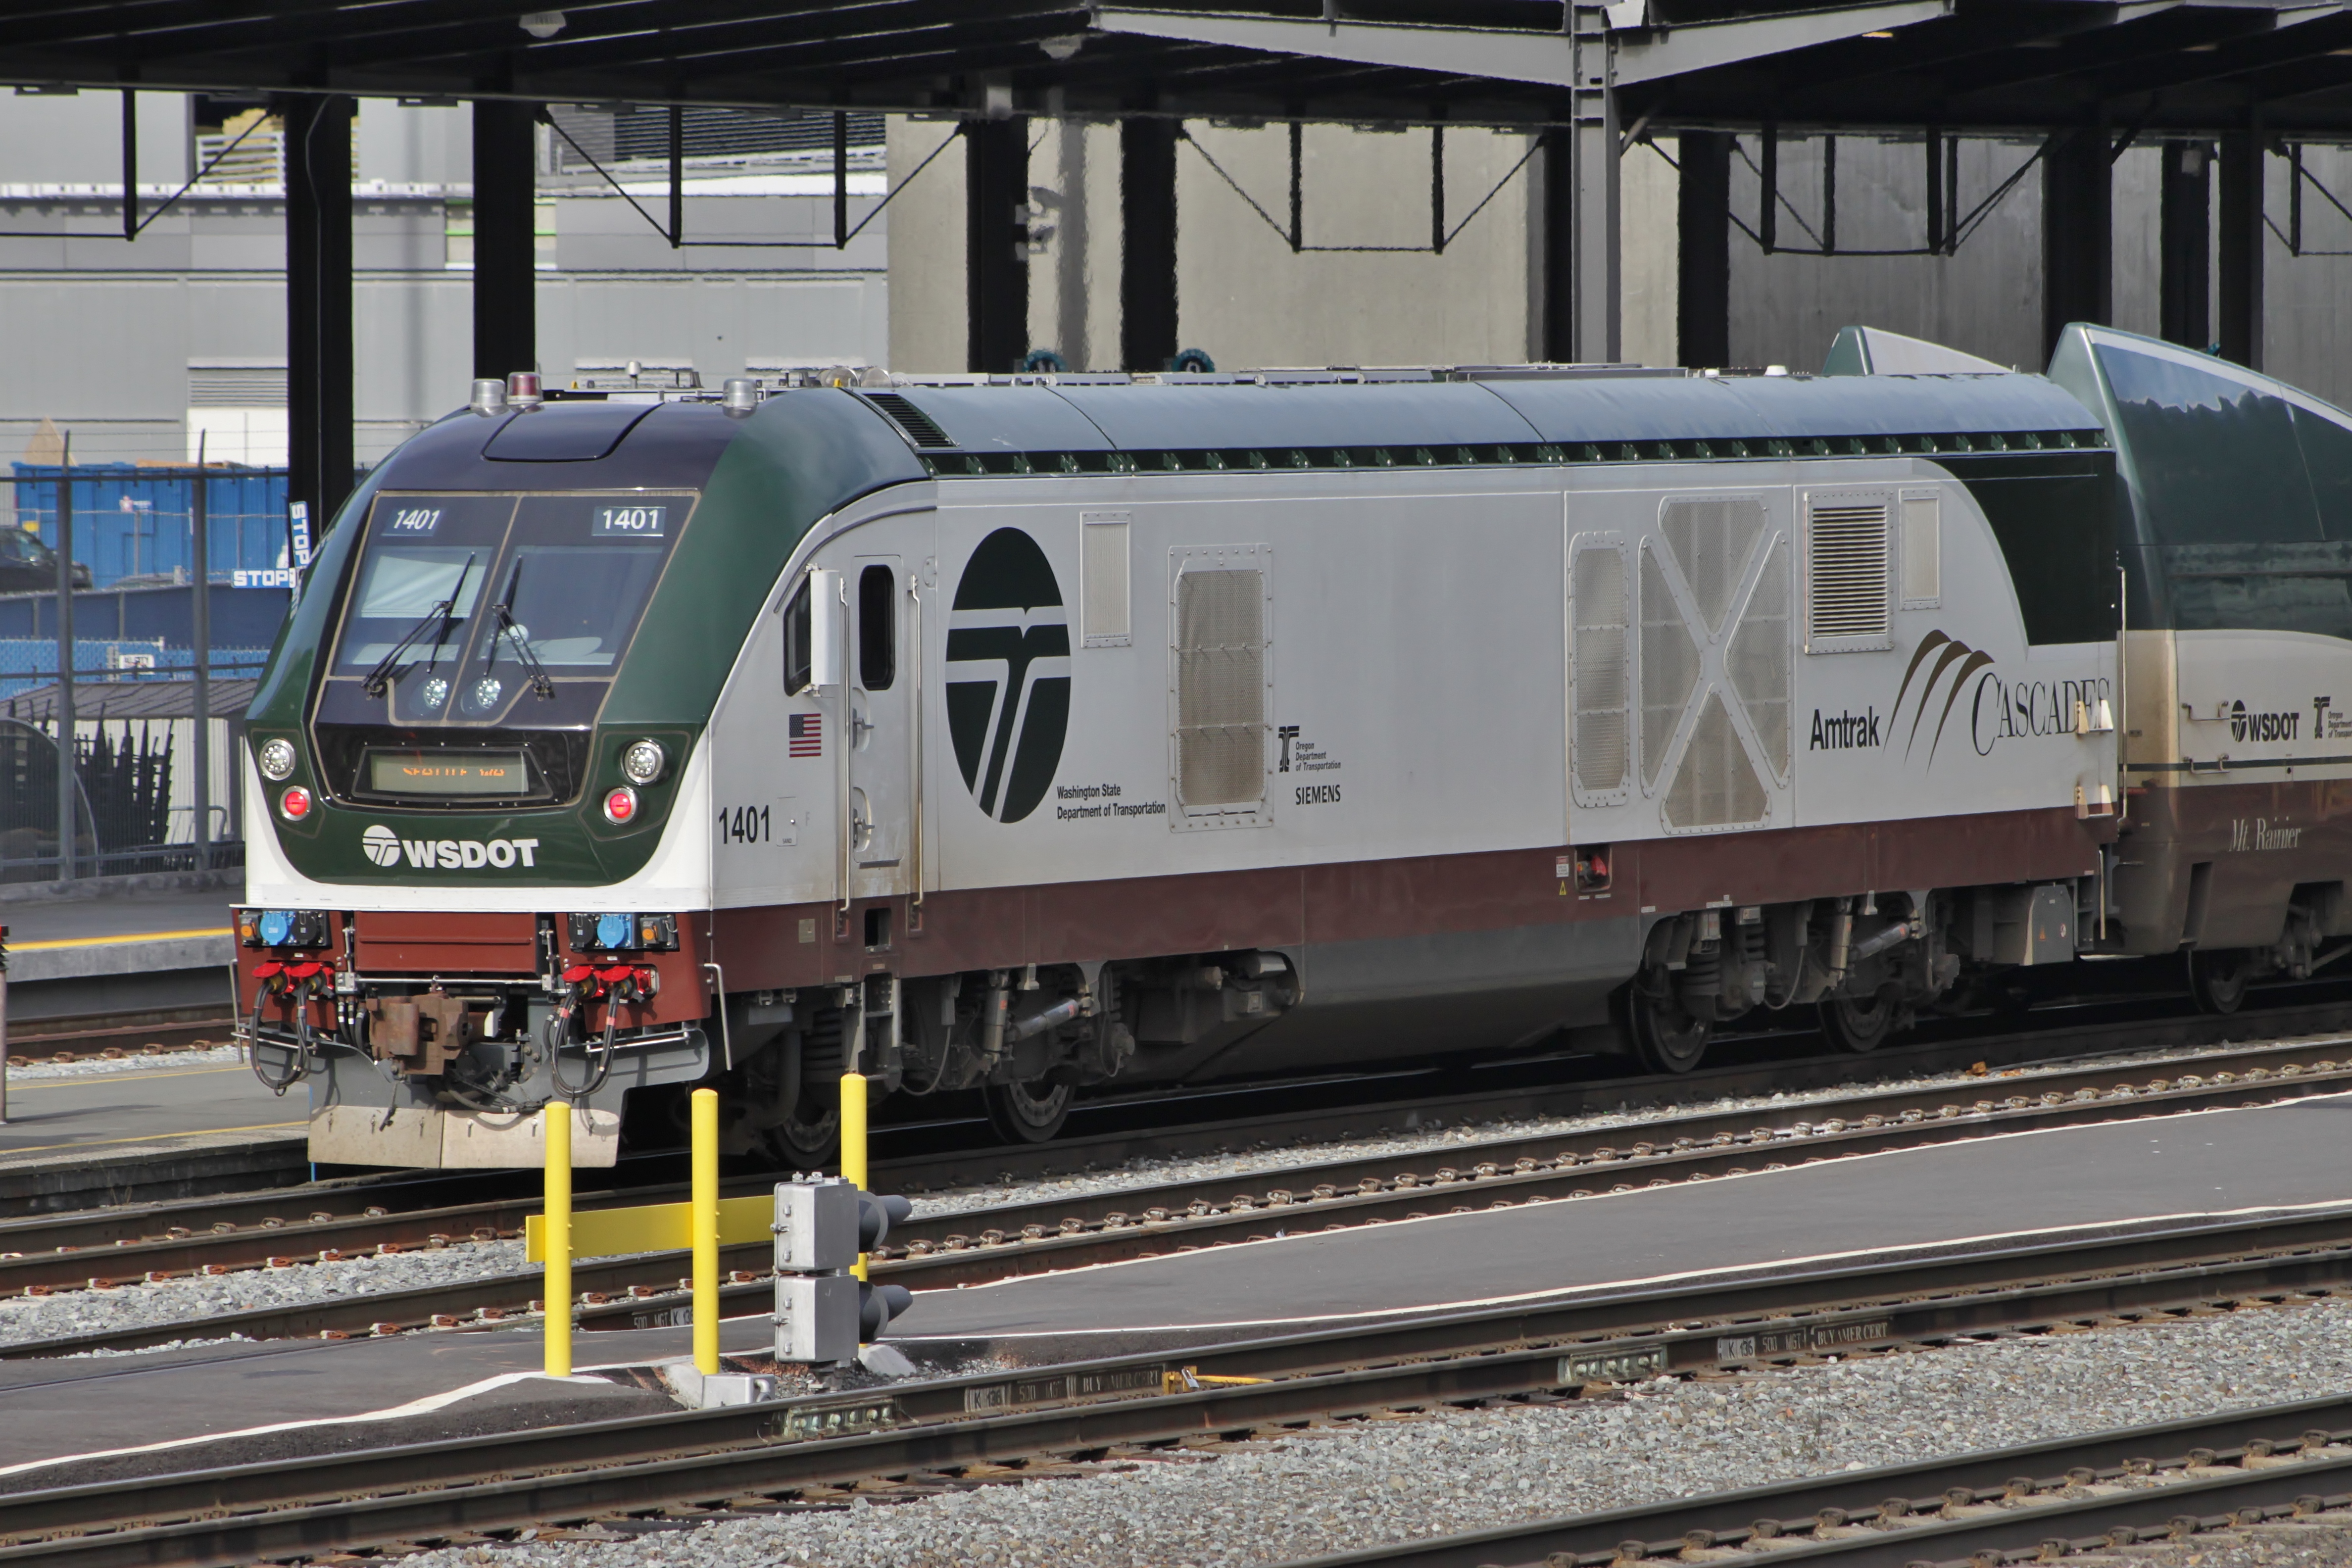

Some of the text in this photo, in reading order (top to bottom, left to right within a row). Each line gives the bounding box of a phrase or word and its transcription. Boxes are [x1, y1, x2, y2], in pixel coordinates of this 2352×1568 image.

[393, 509, 440, 530] 1401
[602, 509, 659, 529] 1401
[292, 503, 311, 565] STOP
[233, 570, 289, 587] STOP
[1810, 706, 1879, 750] Amtrak
[2248, 712, 2299, 742] WSDOT
[1296, 741, 1314, 752] Oregon
[1296, 751, 1326, 762] Department
[1296, 760, 1341, 772] of Transportation
[1057, 784, 1121, 801] Washington State
[1295, 784, 1341, 805] SIEMENS
[1057, 800, 1165, 822] Department of Transportation
[719, 805, 769, 844] 1401
[2255, 816, 2301, 850] Rainier
[401, 838, 539, 869] WSDOT
[673, 1311, 679, 1326] K
[1728, 1342, 1735, 1359] K
[1763, 1336, 1777, 1352] 500
